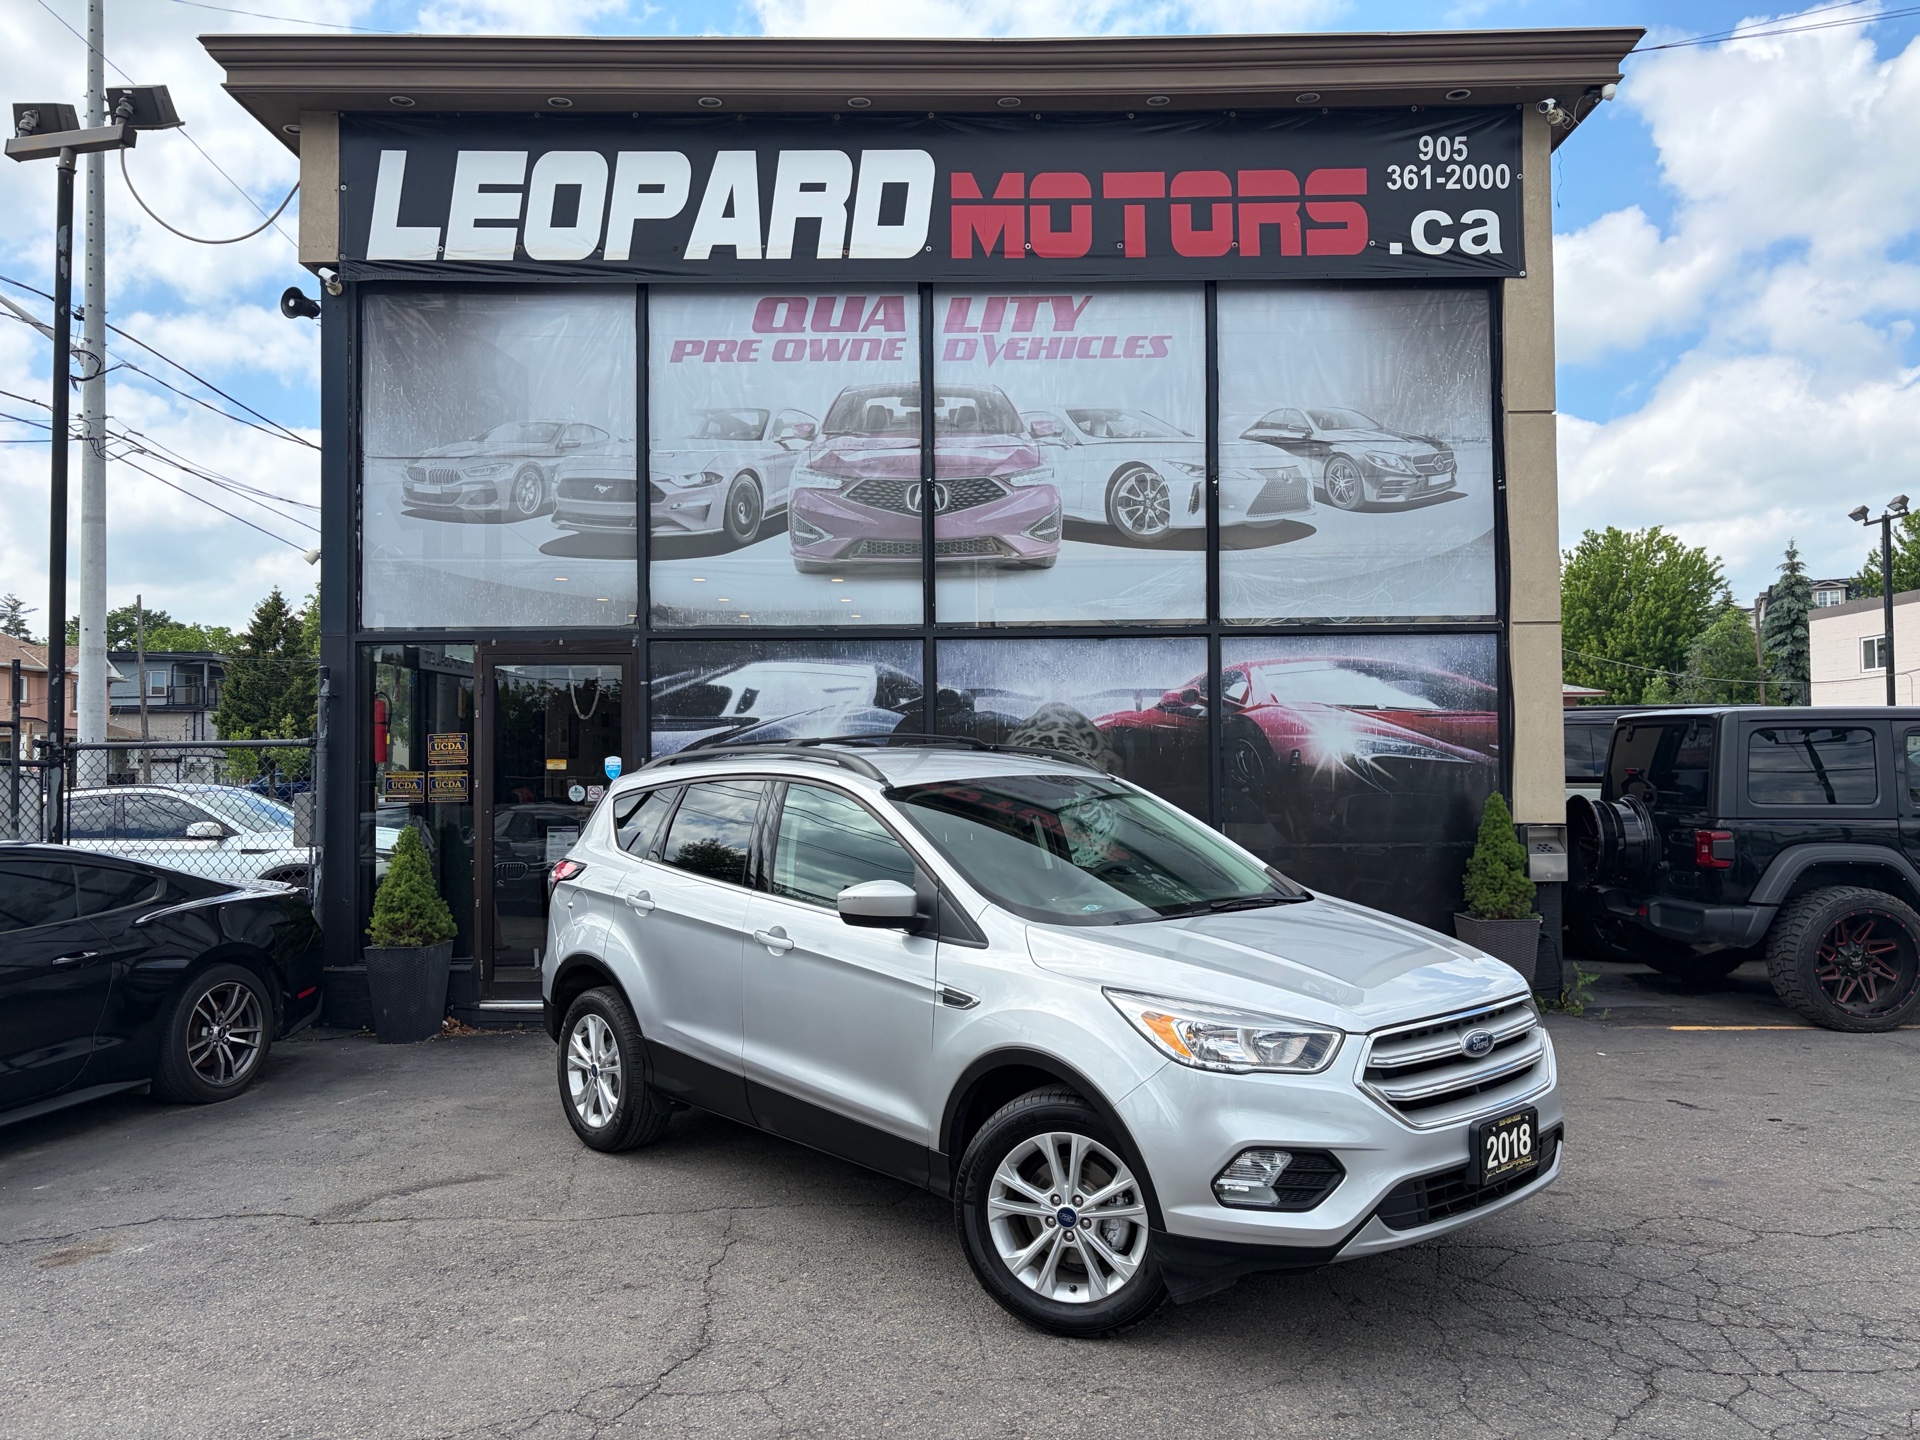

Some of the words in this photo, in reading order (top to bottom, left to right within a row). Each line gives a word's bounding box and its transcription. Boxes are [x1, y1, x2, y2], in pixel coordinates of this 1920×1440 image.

[1418, 135, 1468, 161] 905
[1386, 163, 1511, 190] 361-2000
[366, 149, 936, 261] LEOPARD
[950, 168, 1369, 259] MOTORS
[1389, 209, 1503, 255] .ca
[669, 339, 762, 363] PRE
[434, 742, 462, 750] UCDA
[1472, 1035, 1490, 1050] Ford
[1486, 1123, 1531, 1169] 2018
